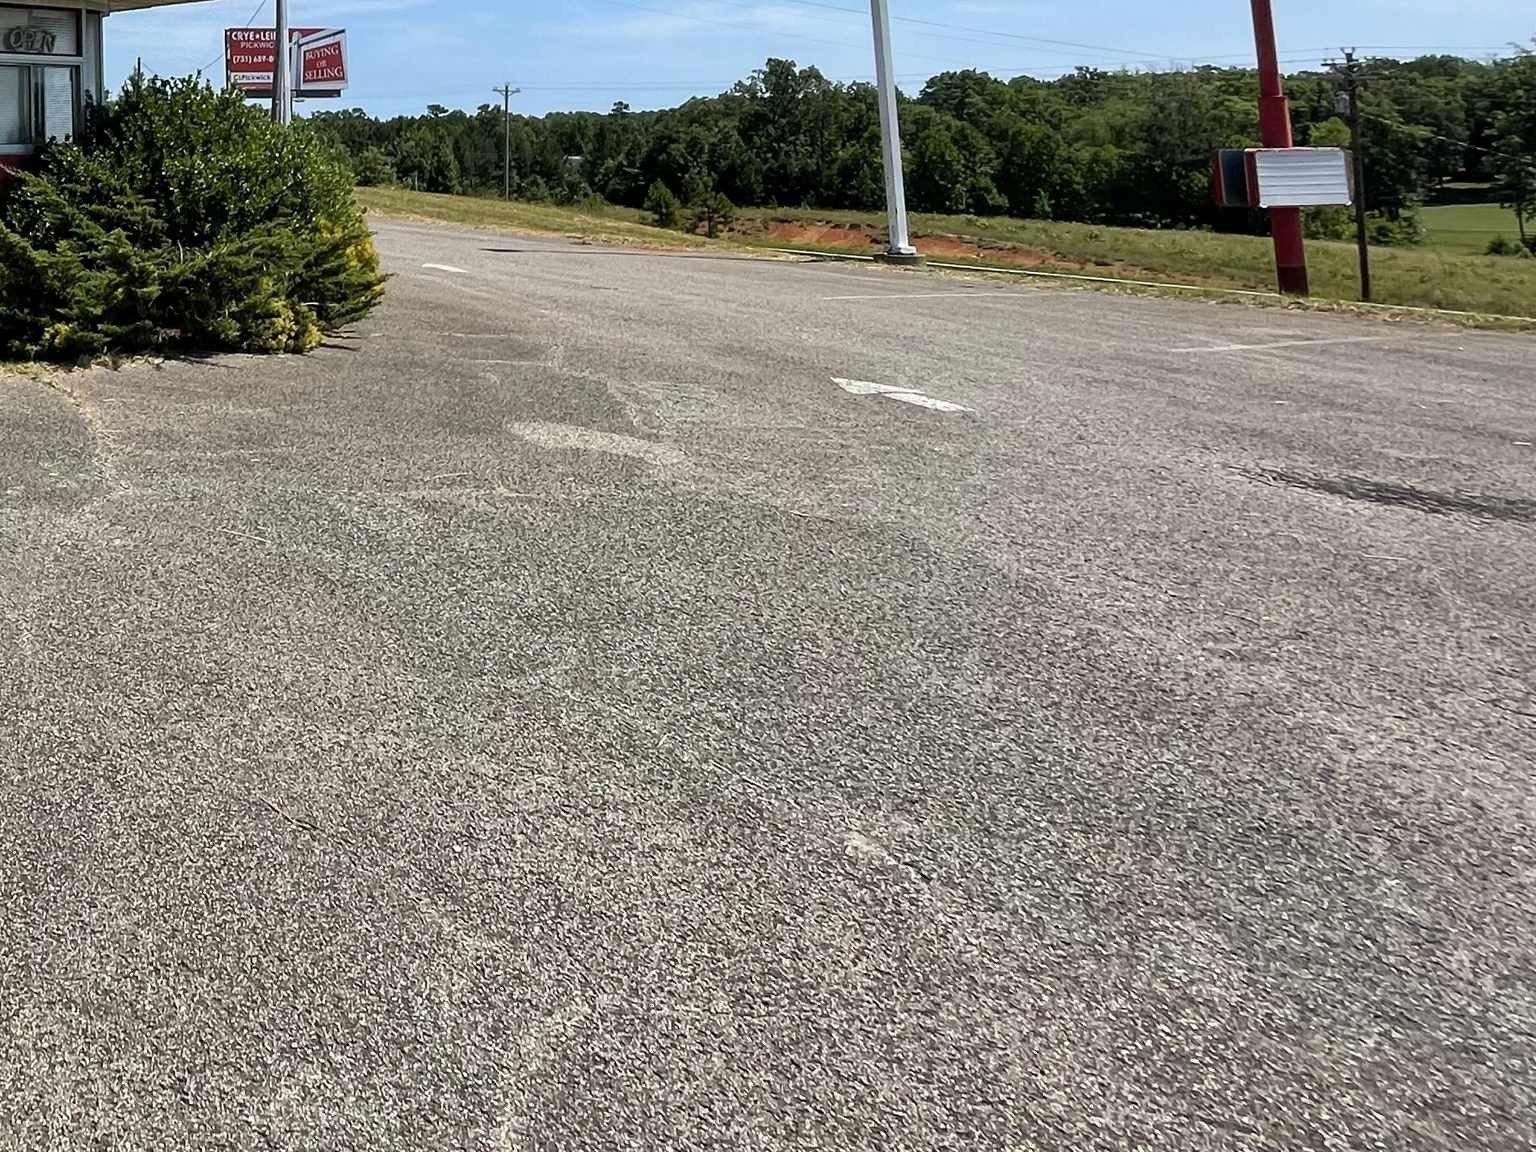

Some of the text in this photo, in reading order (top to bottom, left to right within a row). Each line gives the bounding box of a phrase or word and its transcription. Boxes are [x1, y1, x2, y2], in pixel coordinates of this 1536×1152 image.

[240, 41, 274, 49] PICKWIC
[305, 45, 339, 60] BUYING
[316, 59, 327, 68] OR
[304, 66, 343, 80] SELLING
